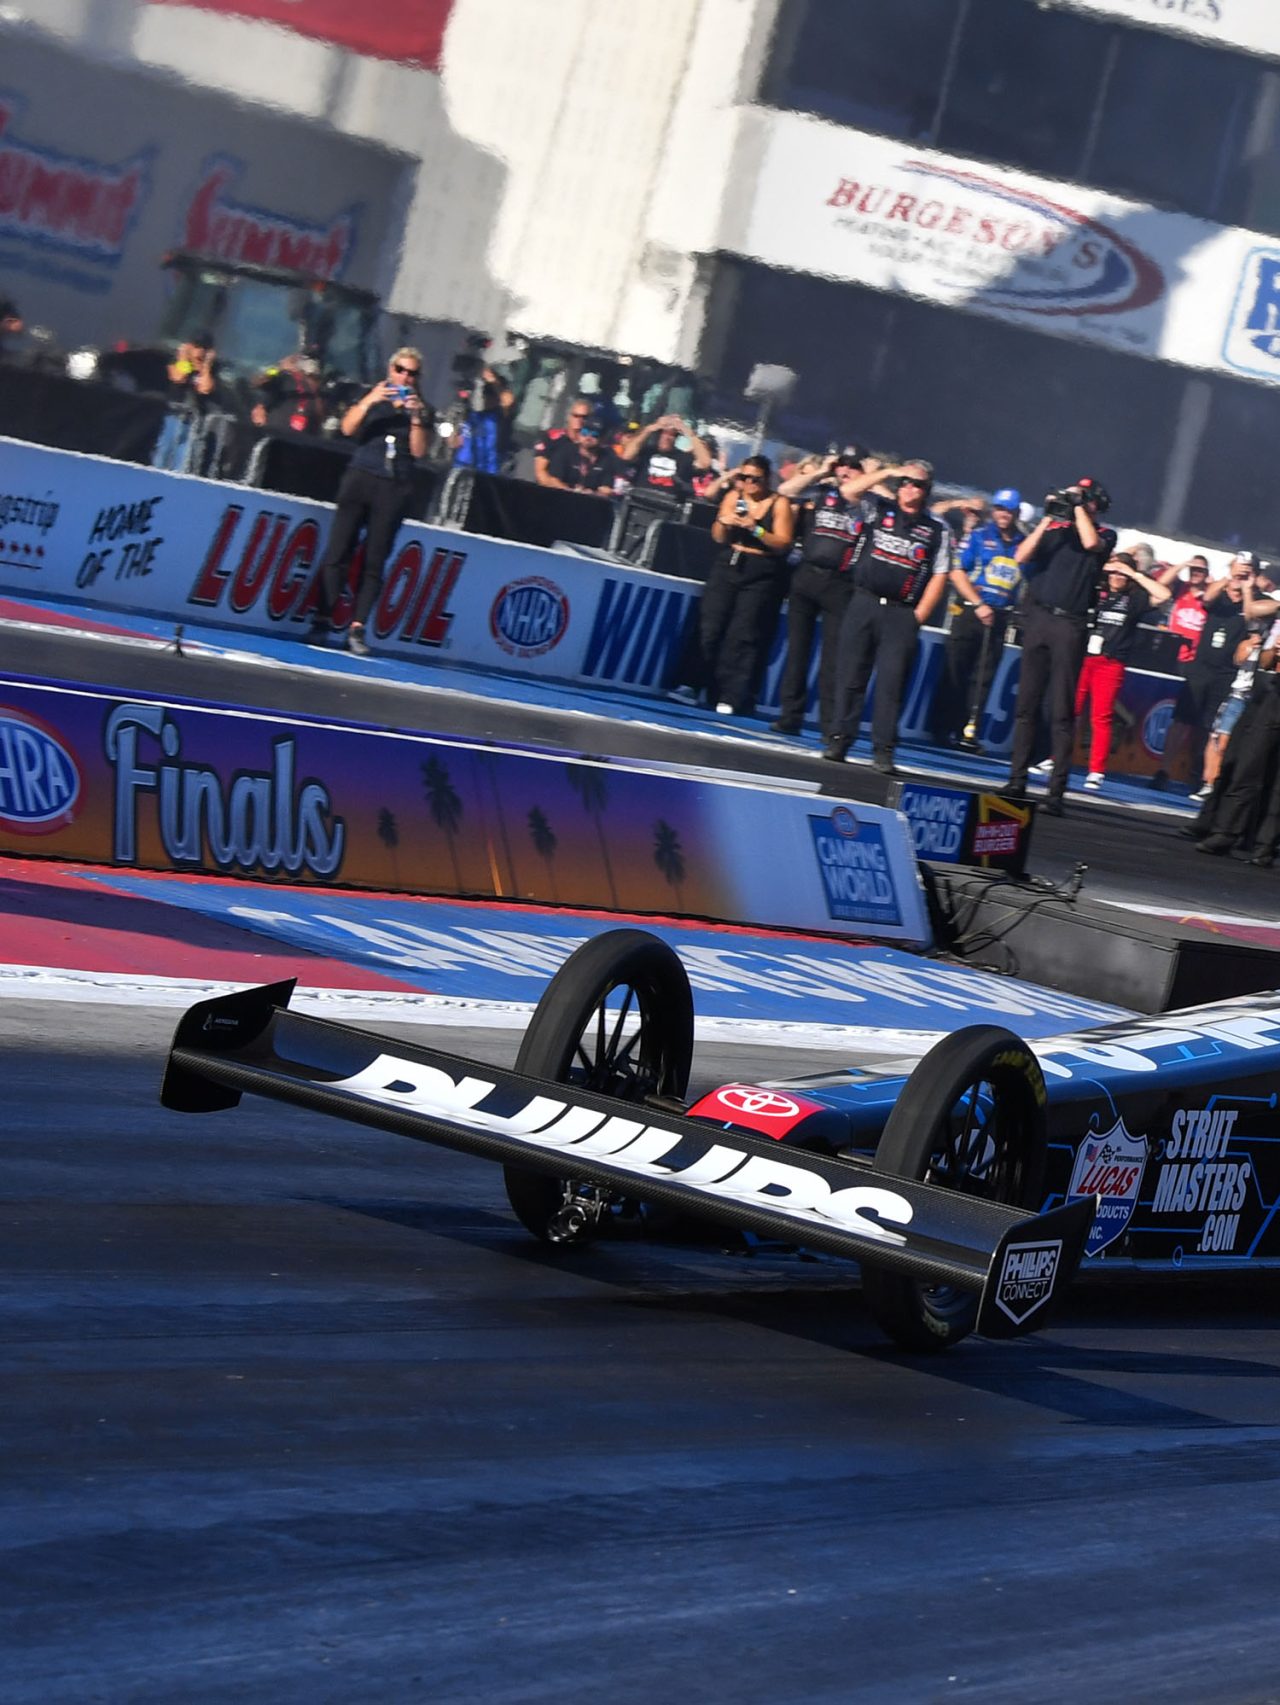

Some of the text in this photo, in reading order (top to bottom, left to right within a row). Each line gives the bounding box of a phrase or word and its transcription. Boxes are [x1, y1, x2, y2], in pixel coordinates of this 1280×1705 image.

[87, 495, 164, 545] HOME
[75, 537, 164, 589] OF THE
[187, 503, 368, 632] LUCS
[374, 540, 468, 648] OIL
[502, 590, 557, 643] NHRA
[0, 727, 70, 811] HRA
[106, 702, 345, 877] Finals
[902, 791, 967, 825] CAMPING
[816, 836, 887, 872] CAMPING
[824, 864, 893, 904] WORLD
[226, 906, 867, 1003] CAMNG
[1166, 1109, 1239, 1160] STRUT
[1076, 1164, 1139, 1196] LUCAS
[1152, 1163, 1250, 1213] MASTERS
[1089, 1226, 1103, 1240] NC.
[1095, 1204, 1129, 1219] ODUCTS
[1196, 1214, 1240, 1252] .COM
[1004, 1250, 1056, 1280] PHILLIPS
[1003, 1281, 1048, 1301] CONNECT
